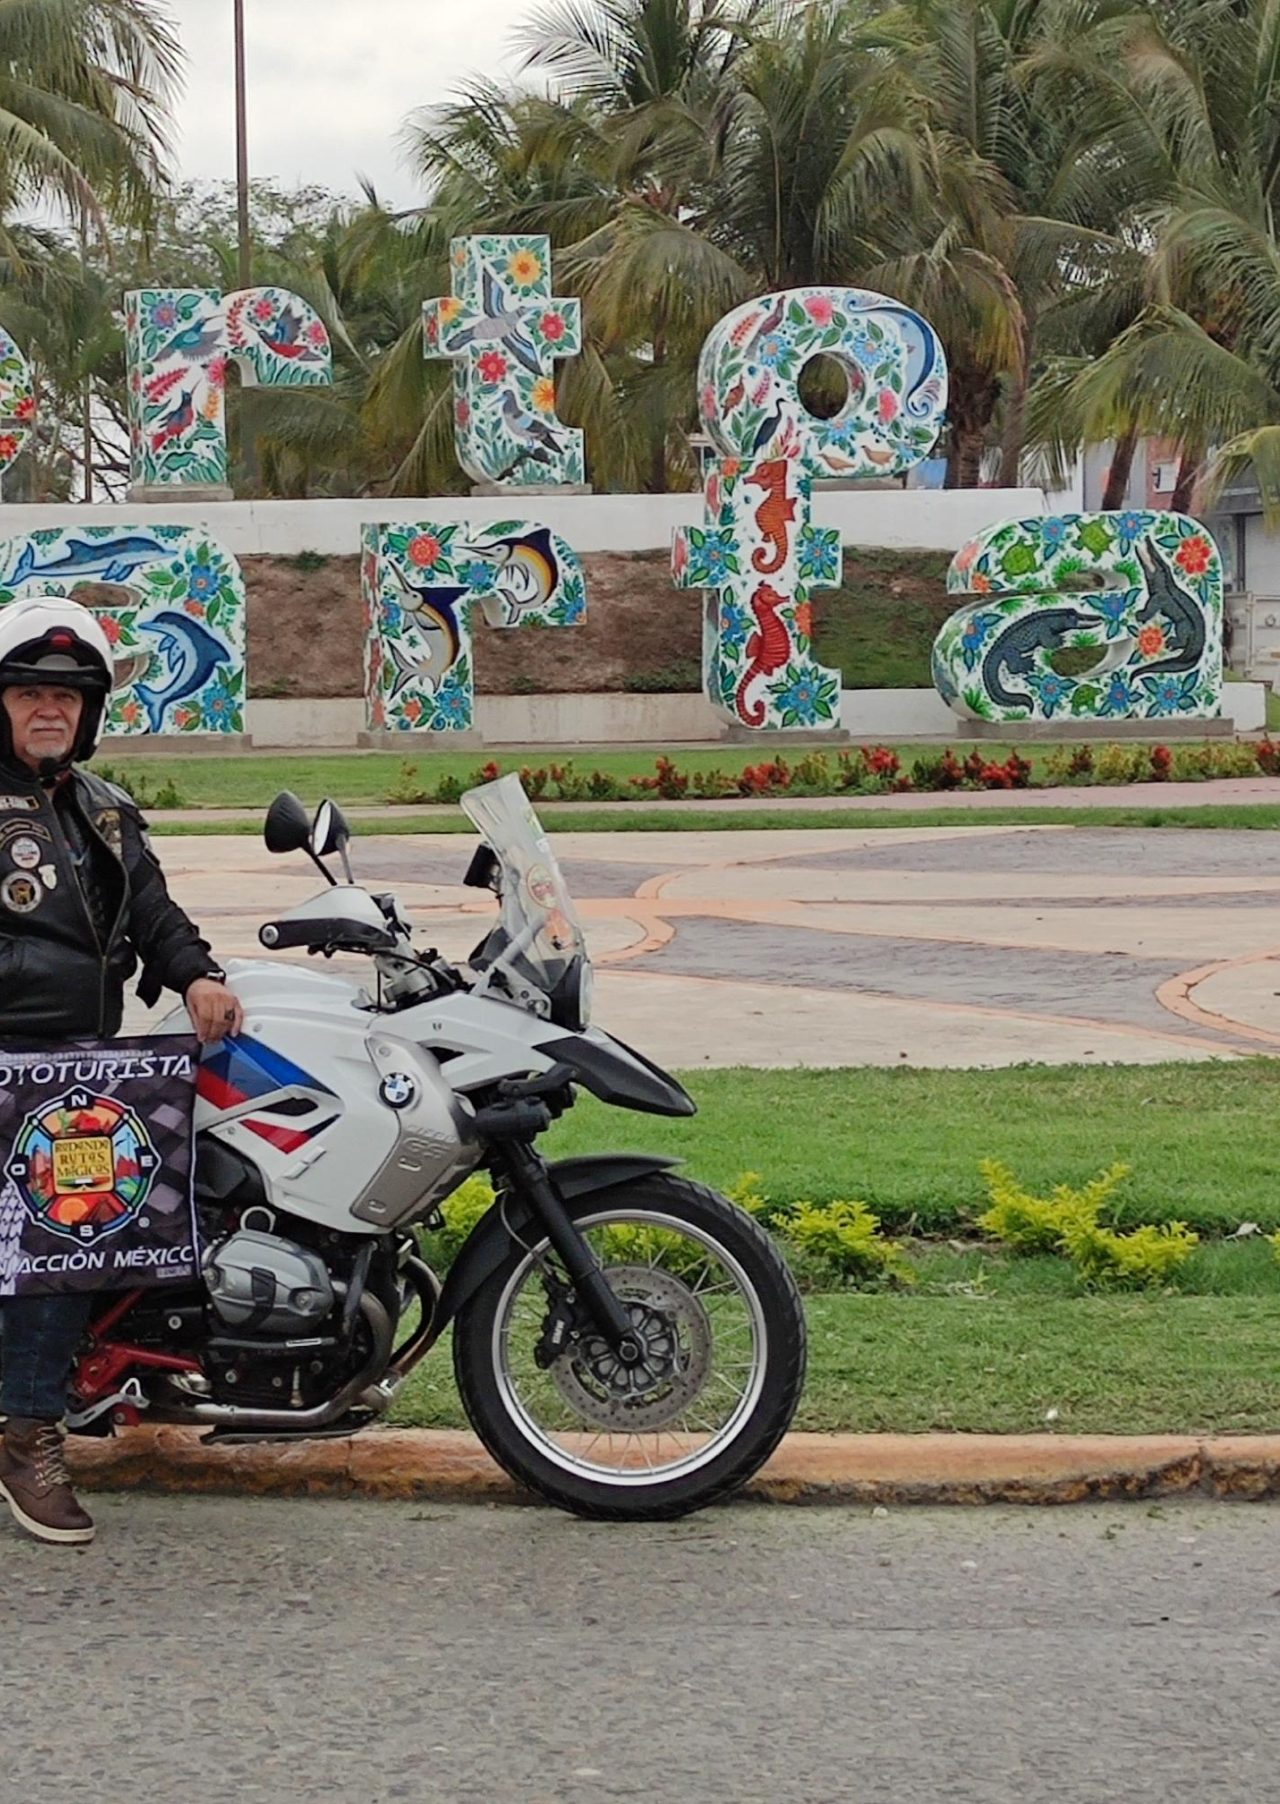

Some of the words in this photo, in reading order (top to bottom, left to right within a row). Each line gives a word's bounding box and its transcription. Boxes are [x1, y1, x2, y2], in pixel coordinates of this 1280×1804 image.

[70, 1094, 88, 1107] N
[140, 1155, 154, 1168] E
[10, 1163, 26, 1176] O
[79, 1224, 94, 1237] S
[18, 1249, 105, 1273] ACCIÓN
